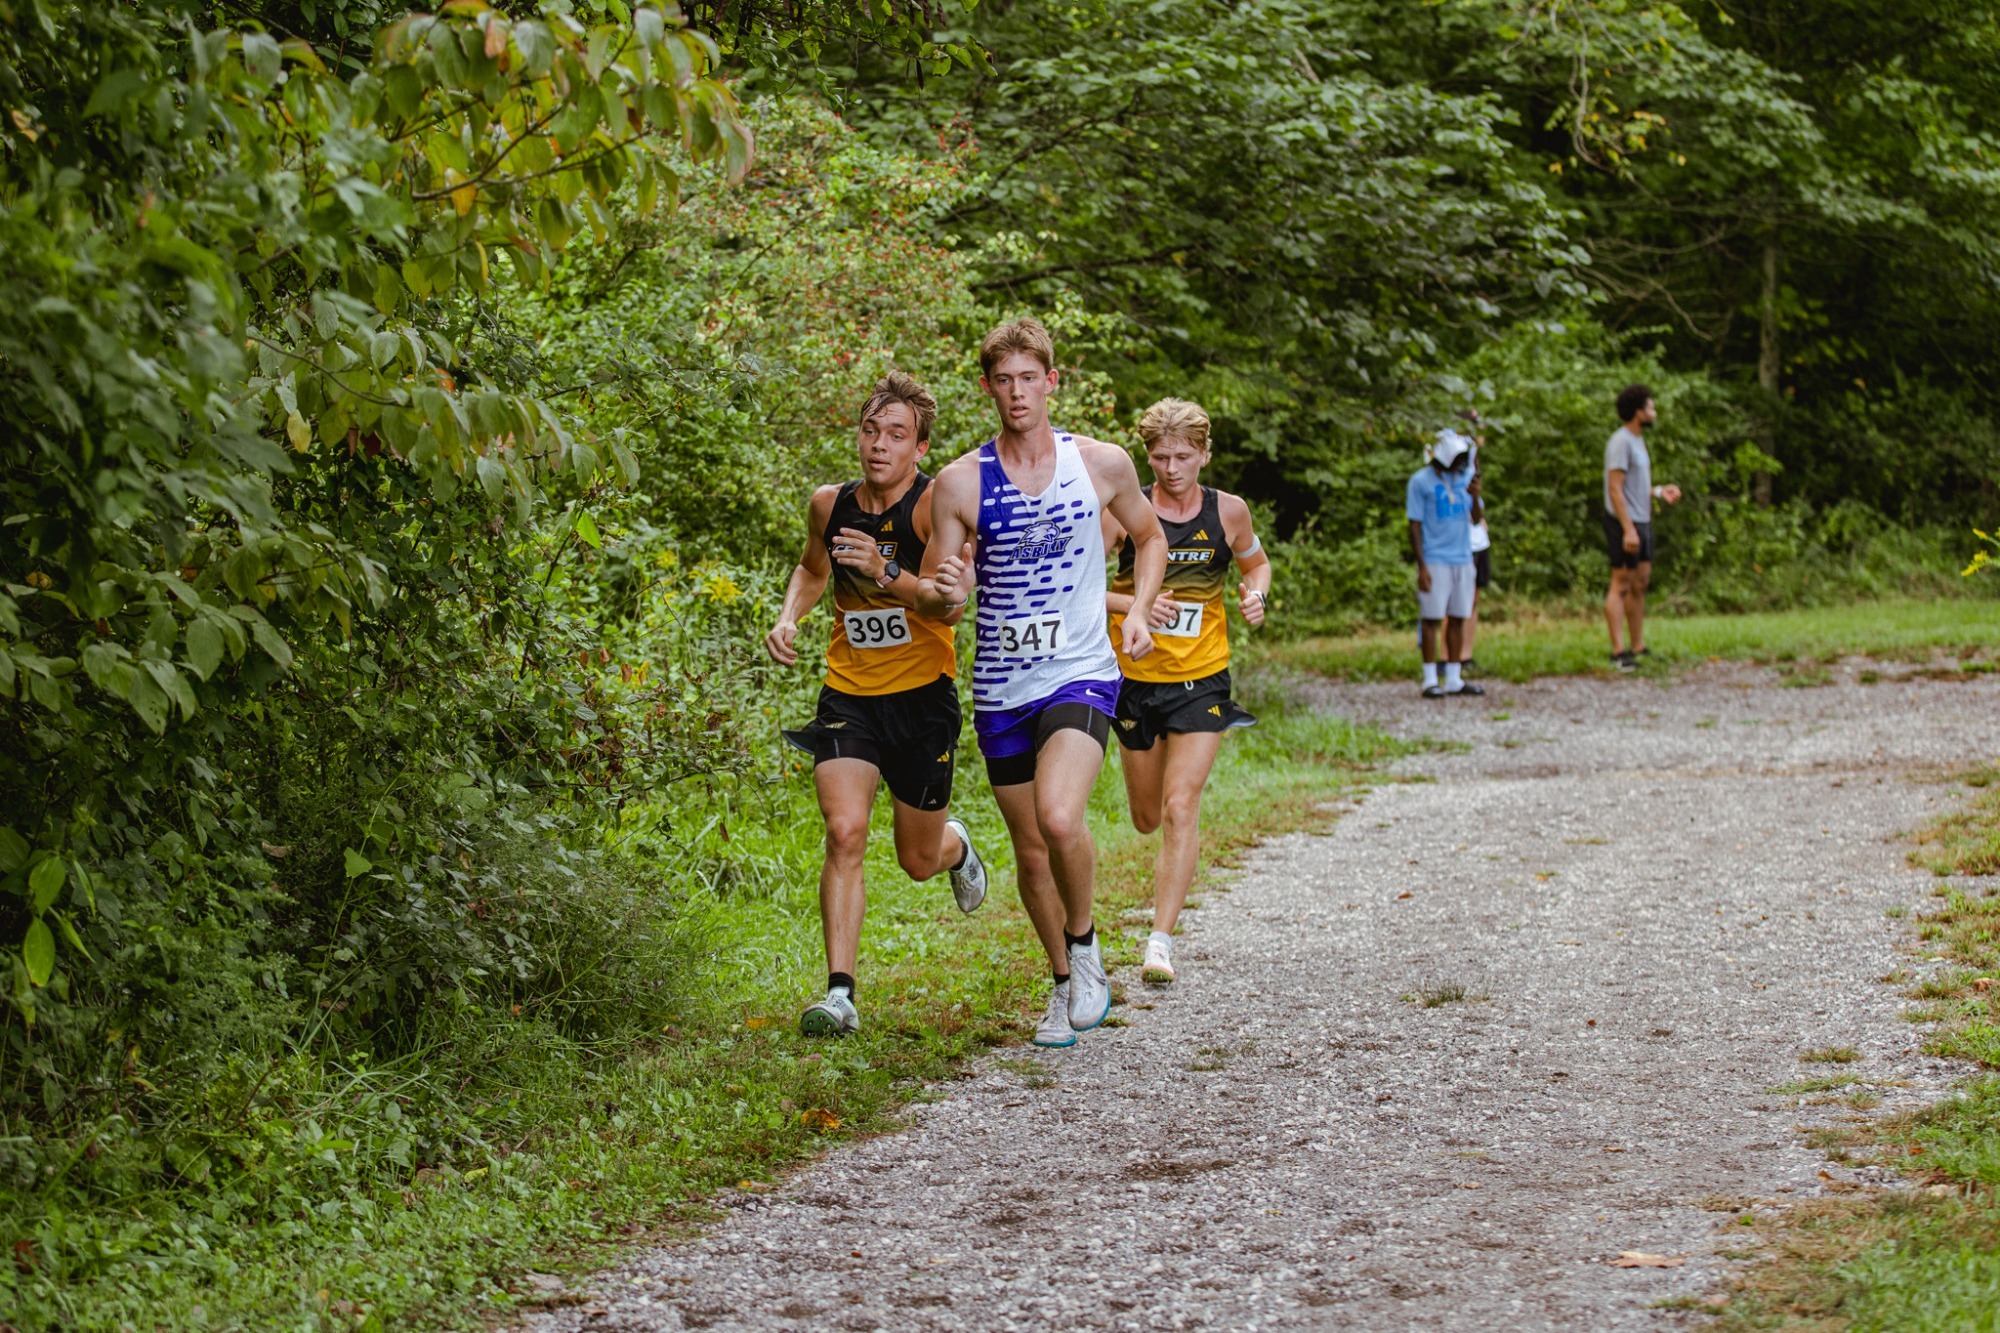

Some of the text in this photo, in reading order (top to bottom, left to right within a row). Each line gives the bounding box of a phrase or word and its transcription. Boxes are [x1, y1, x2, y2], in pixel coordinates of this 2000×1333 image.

[834, 545, 894, 556] CEE
[1167, 551, 1211, 561] NTRE
[848, 615, 906, 643] 396
[1165, 607, 1199, 631] 07
[1002, 620, 1061, 652] 347
